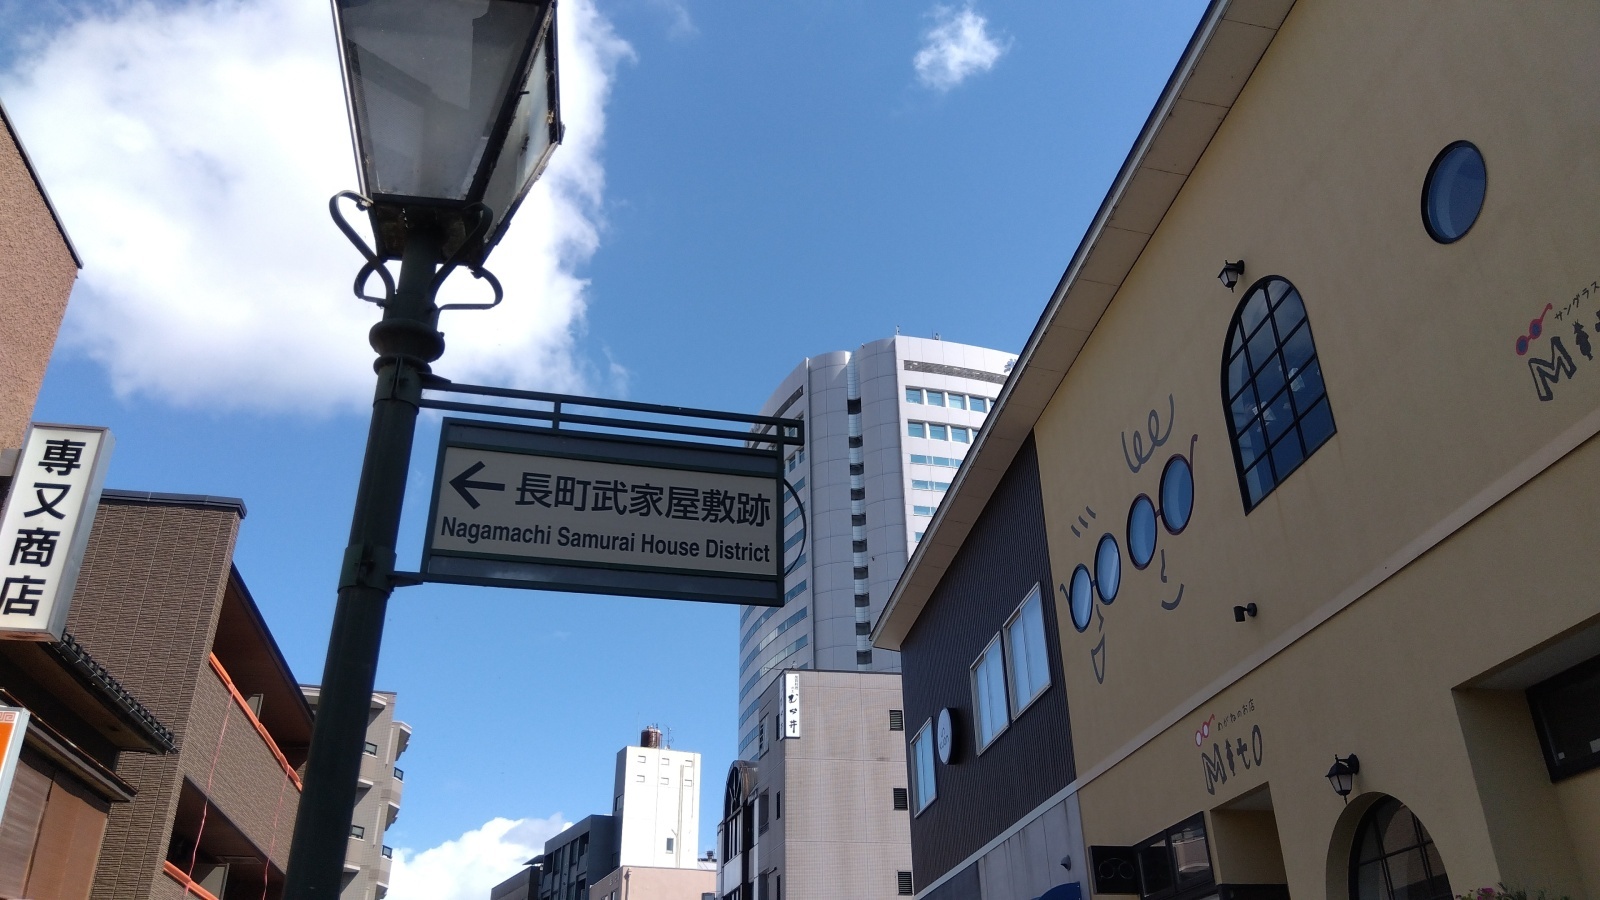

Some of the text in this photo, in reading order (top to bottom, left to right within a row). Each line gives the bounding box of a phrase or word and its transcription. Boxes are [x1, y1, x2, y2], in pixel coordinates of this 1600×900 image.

[514, 471, 772, 528] 長町武家屋敷跡
[0, 439, 86, 617] 専又商店
[441, 516, 770, 562] Nagamachi Samurai House District
[1217, 698, 1255, 731] めがねのお店
